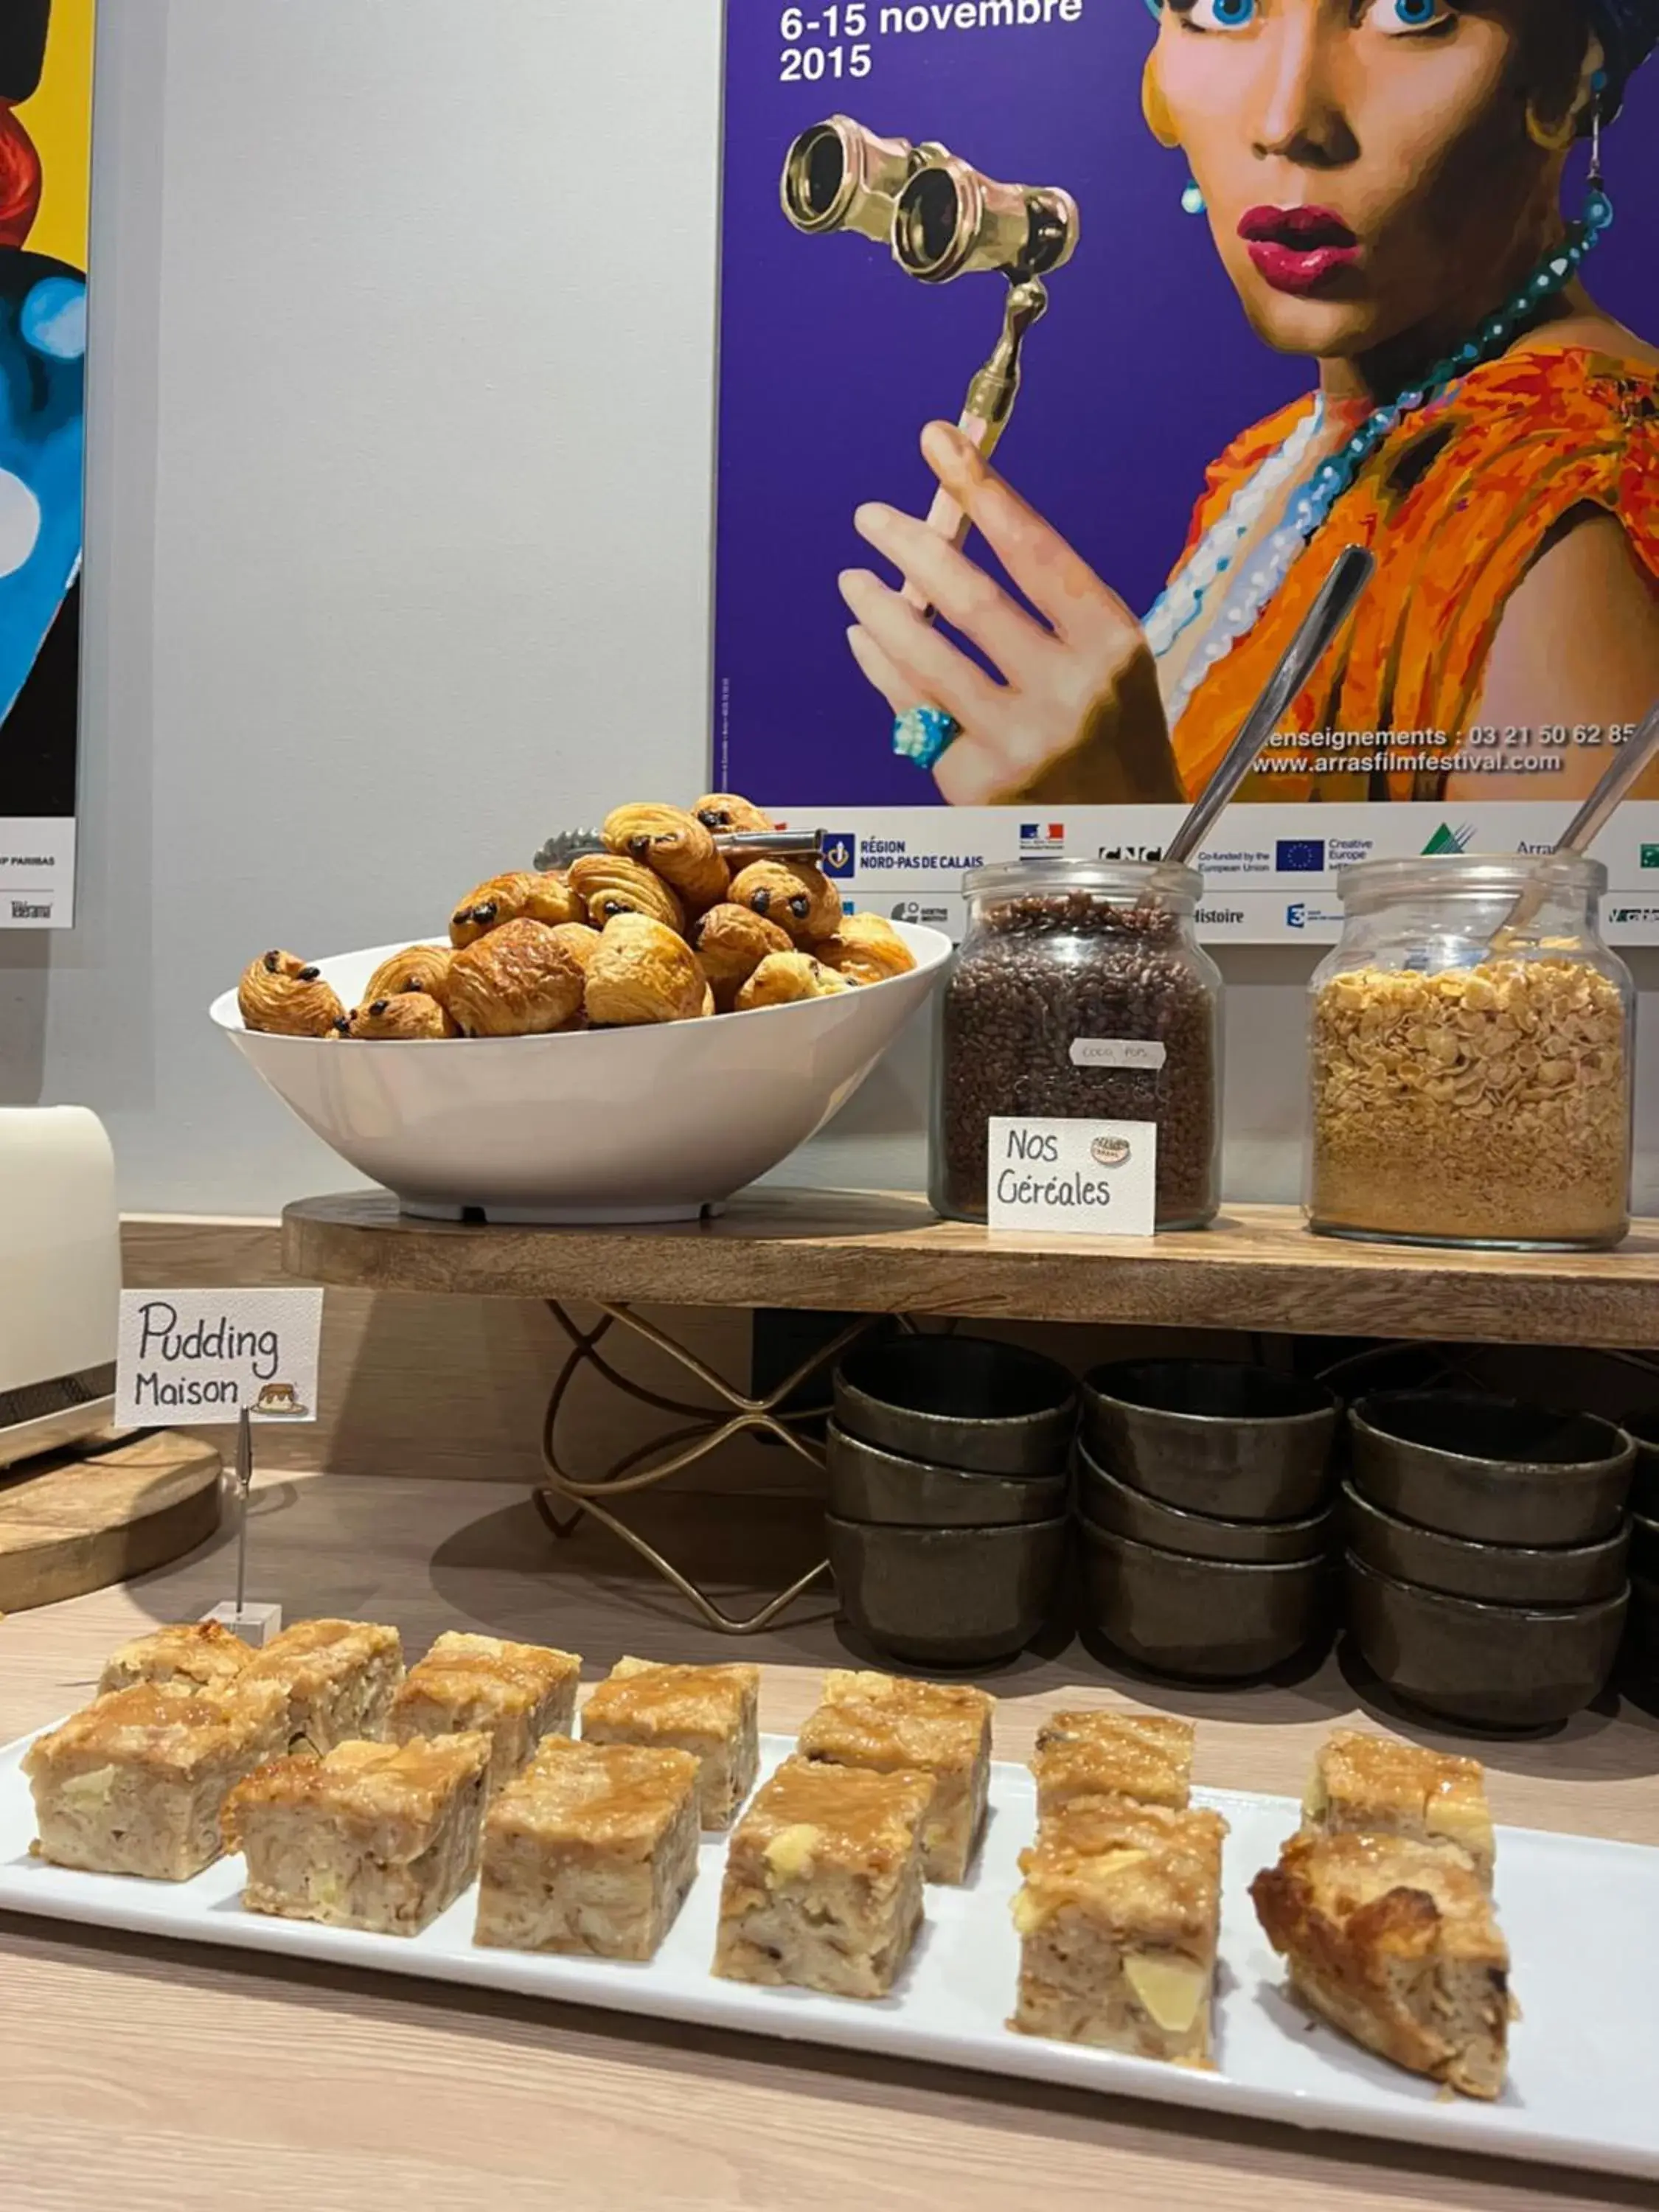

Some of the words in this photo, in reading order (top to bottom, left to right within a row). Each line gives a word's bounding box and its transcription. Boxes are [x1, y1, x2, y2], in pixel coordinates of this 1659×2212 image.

[780, 3, 867, 41] 6-15
[880, 0, 1083, 34] novembre
[779, 44, 872, 82] 2015
[1265, 727, 1447, 751] enseignements
[1470, 726, 1495, 745] 03
[1504, 725, 1528, 744] 21
[1539, 724, 1565, 744] 50
[1572, 724, 1601, 743] 62
[1253, 750, 1561, 772] www.arrasfilmfestival.com
[860, 836, 906, 854] RÉGION
[1329, 838, 1374, 849] Creative
[939, 855, 984, 869] CALAIS
[1198, 851, 1242, 861] Co-funded
[1244, 852, 1253, 863] by
[1255, 851, 1270, 861] the
[1329, 850, 1367, 861] Europe
[1198, 863, 1241, 874] European
[1243, 863, 1270, 872] Union
[138, 1301, 279, 1380] Pudding
[134, 1371, 239, 1406] Maison
